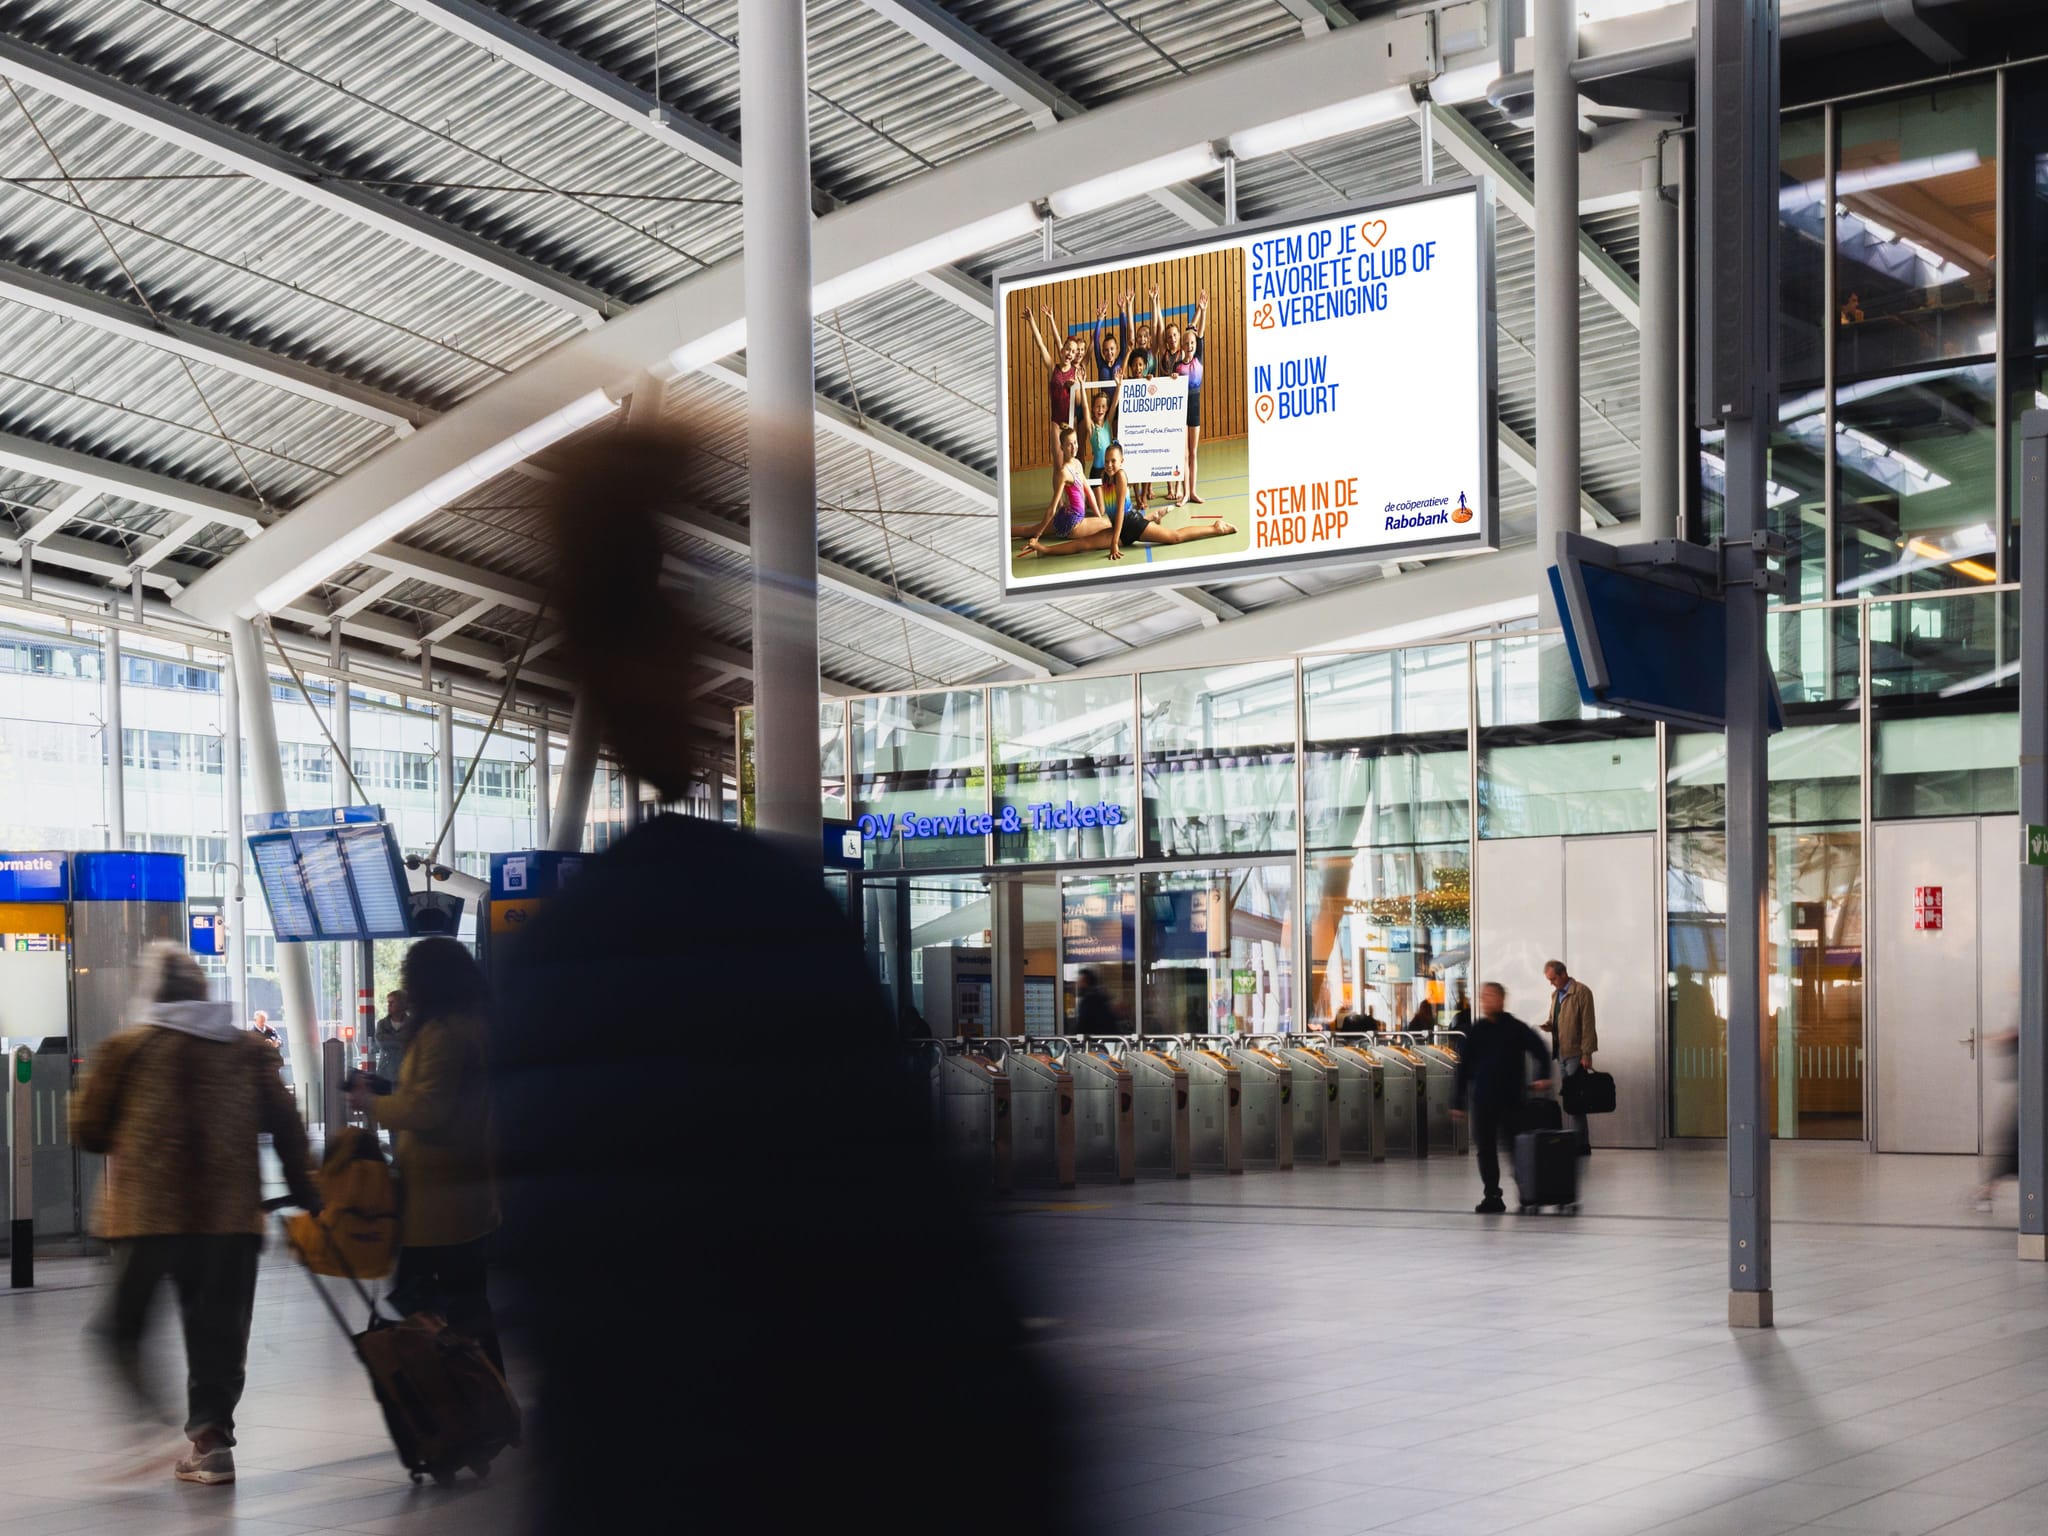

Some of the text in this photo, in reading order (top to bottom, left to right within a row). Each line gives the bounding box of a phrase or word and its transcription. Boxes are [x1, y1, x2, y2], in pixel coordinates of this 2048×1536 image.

[1252, 224, 1357, 271] STEM OP JE
[1252, 241, 1437, 301] FAVORIETE CLUB OF
[1278, 282, 1388, 327] VERENIGING
[1123, 383, 1147, 399] RABO
[1254, 355, 1327, 394] IN JOUW
[1122, 396, 1184, 413] CLUBSUPPORT
[1279, 383, 1340, 420] BUURT
[1256, 477, 1359, 518] STEM IN DE
[1384, 496, 1449, 513] de coöperatieve
[1256, 510, 1349, 549] RABO APP
[1384, 509, 1449, 531] Rabobank
[858, 800, 1123, 840] OV Service & Tickets
